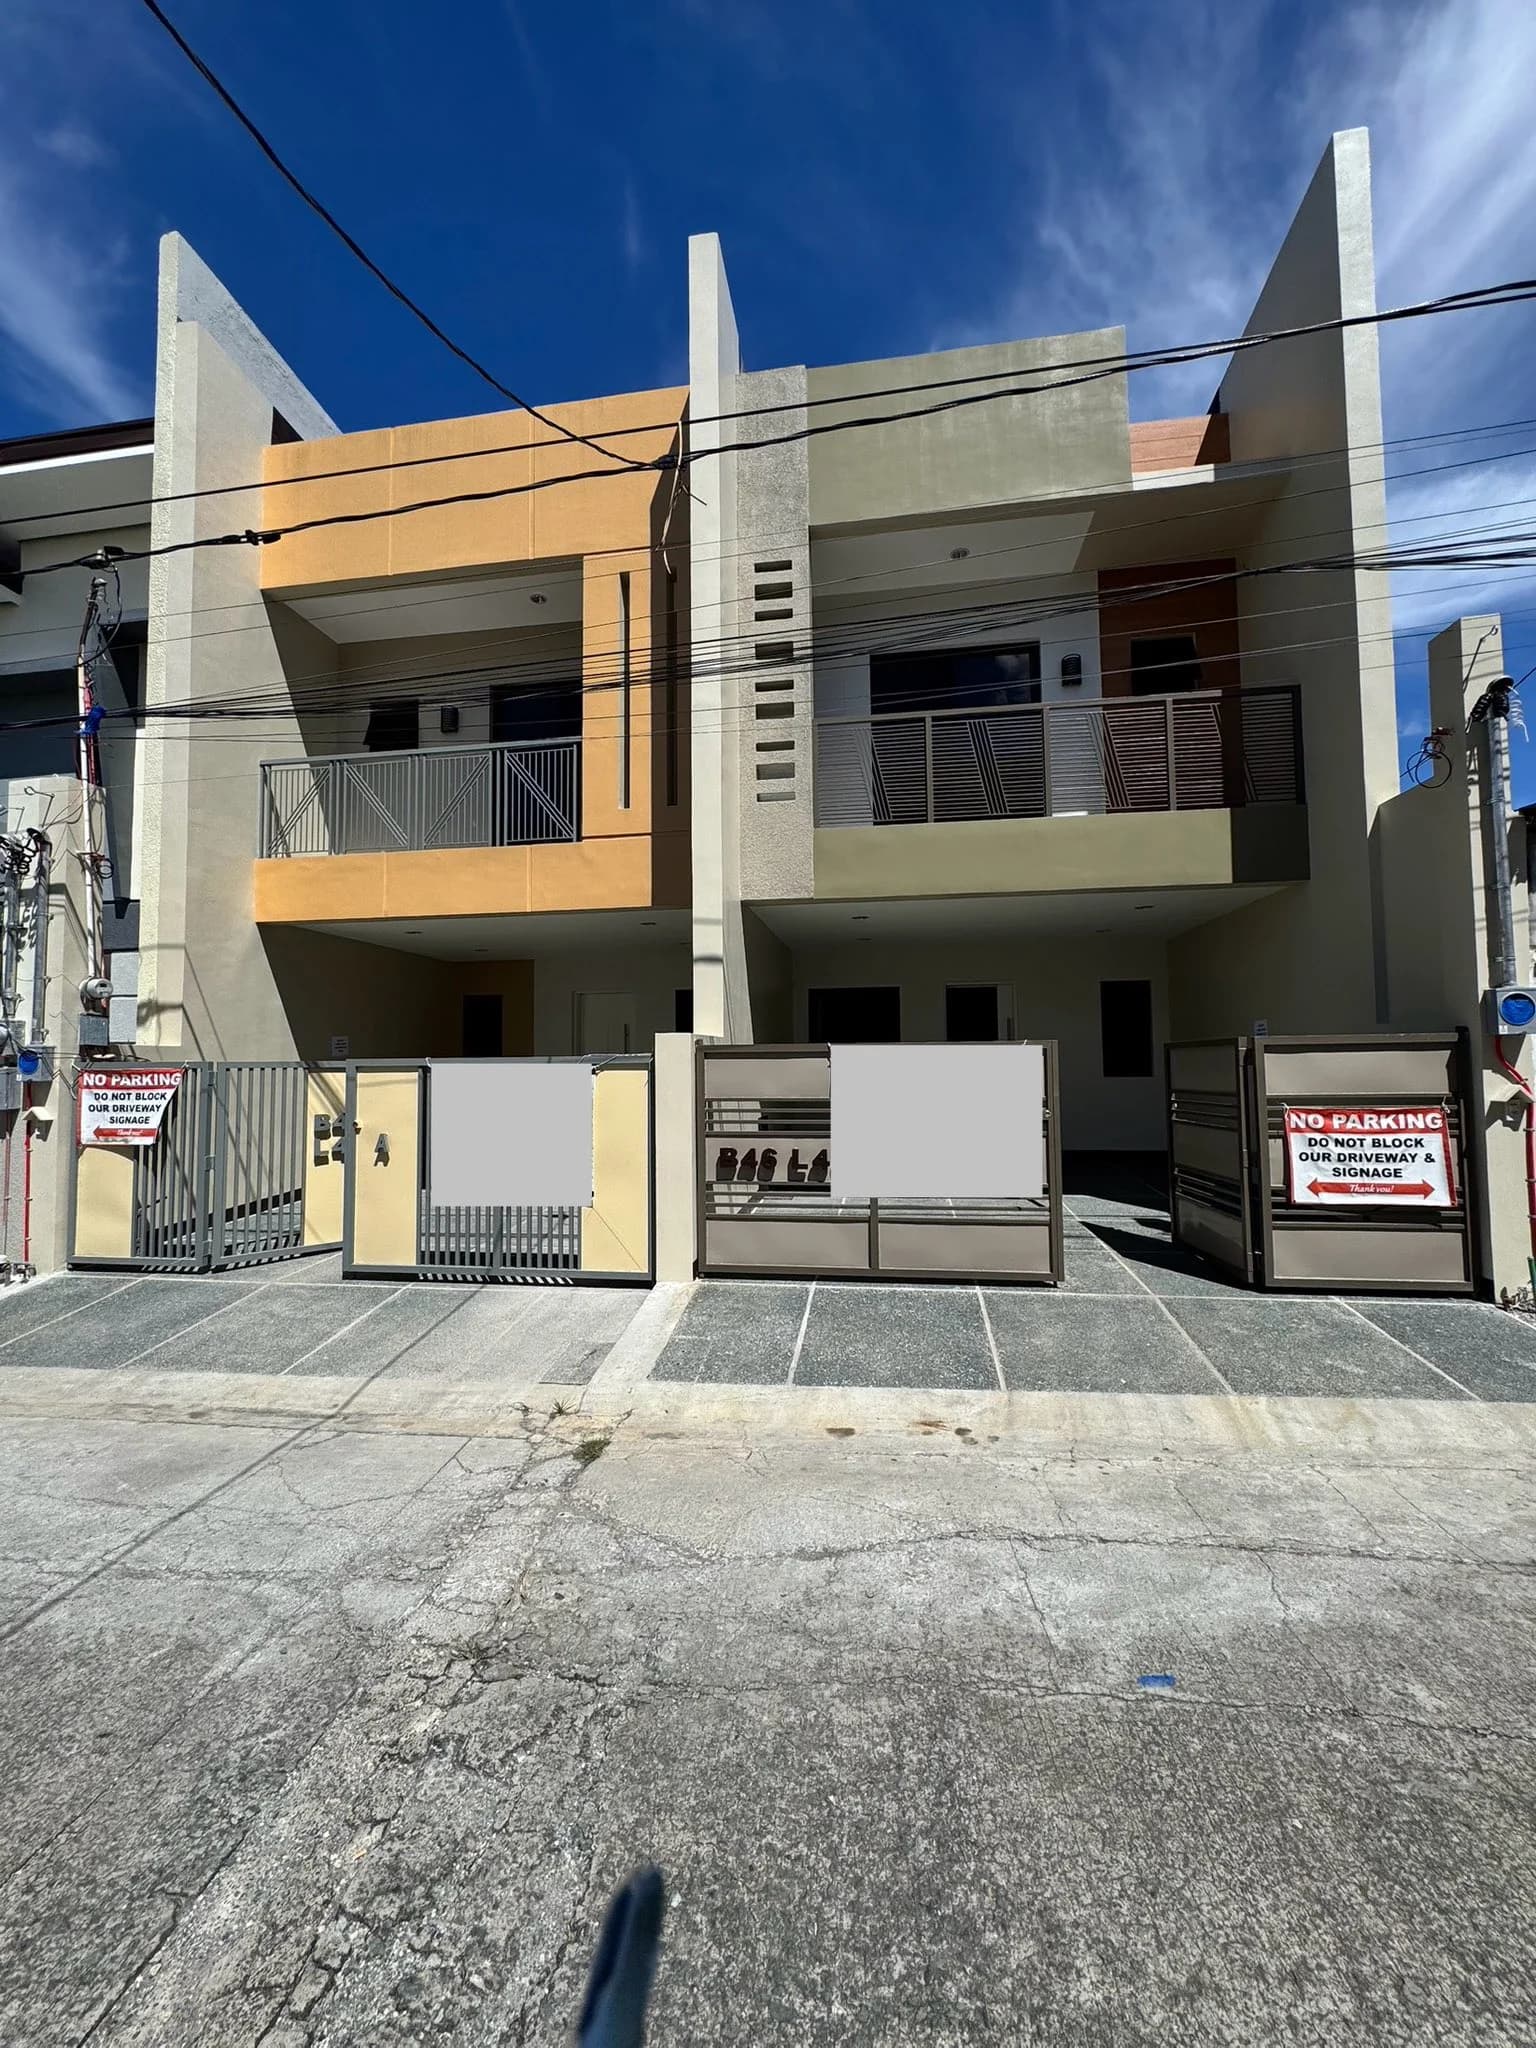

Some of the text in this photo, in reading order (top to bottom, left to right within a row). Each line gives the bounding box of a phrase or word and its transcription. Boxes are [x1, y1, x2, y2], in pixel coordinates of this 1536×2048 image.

[83, 1072, 182, 1086] NO PARKING
[94, 1092, 167, 1101] DO NOT BLOCK
[88, 1104, 161, 1112] OUR DRIVEWAY
[109, 1116, 150, 1124] SIGNAGE
[1290, 1112, 1443, 1129] NO PARKING
[1308, 1137, 1425, 1148] DO NOT BLOCK
[717, 1147, 831, 1171] B46 L4
[1299, 1151, 1435, 1163] OUR DRIVEWAY &
[1332, 1167, 1403, 1178] SIGNAGE
[1350, 1184, 1395, 1194] Thank you!
